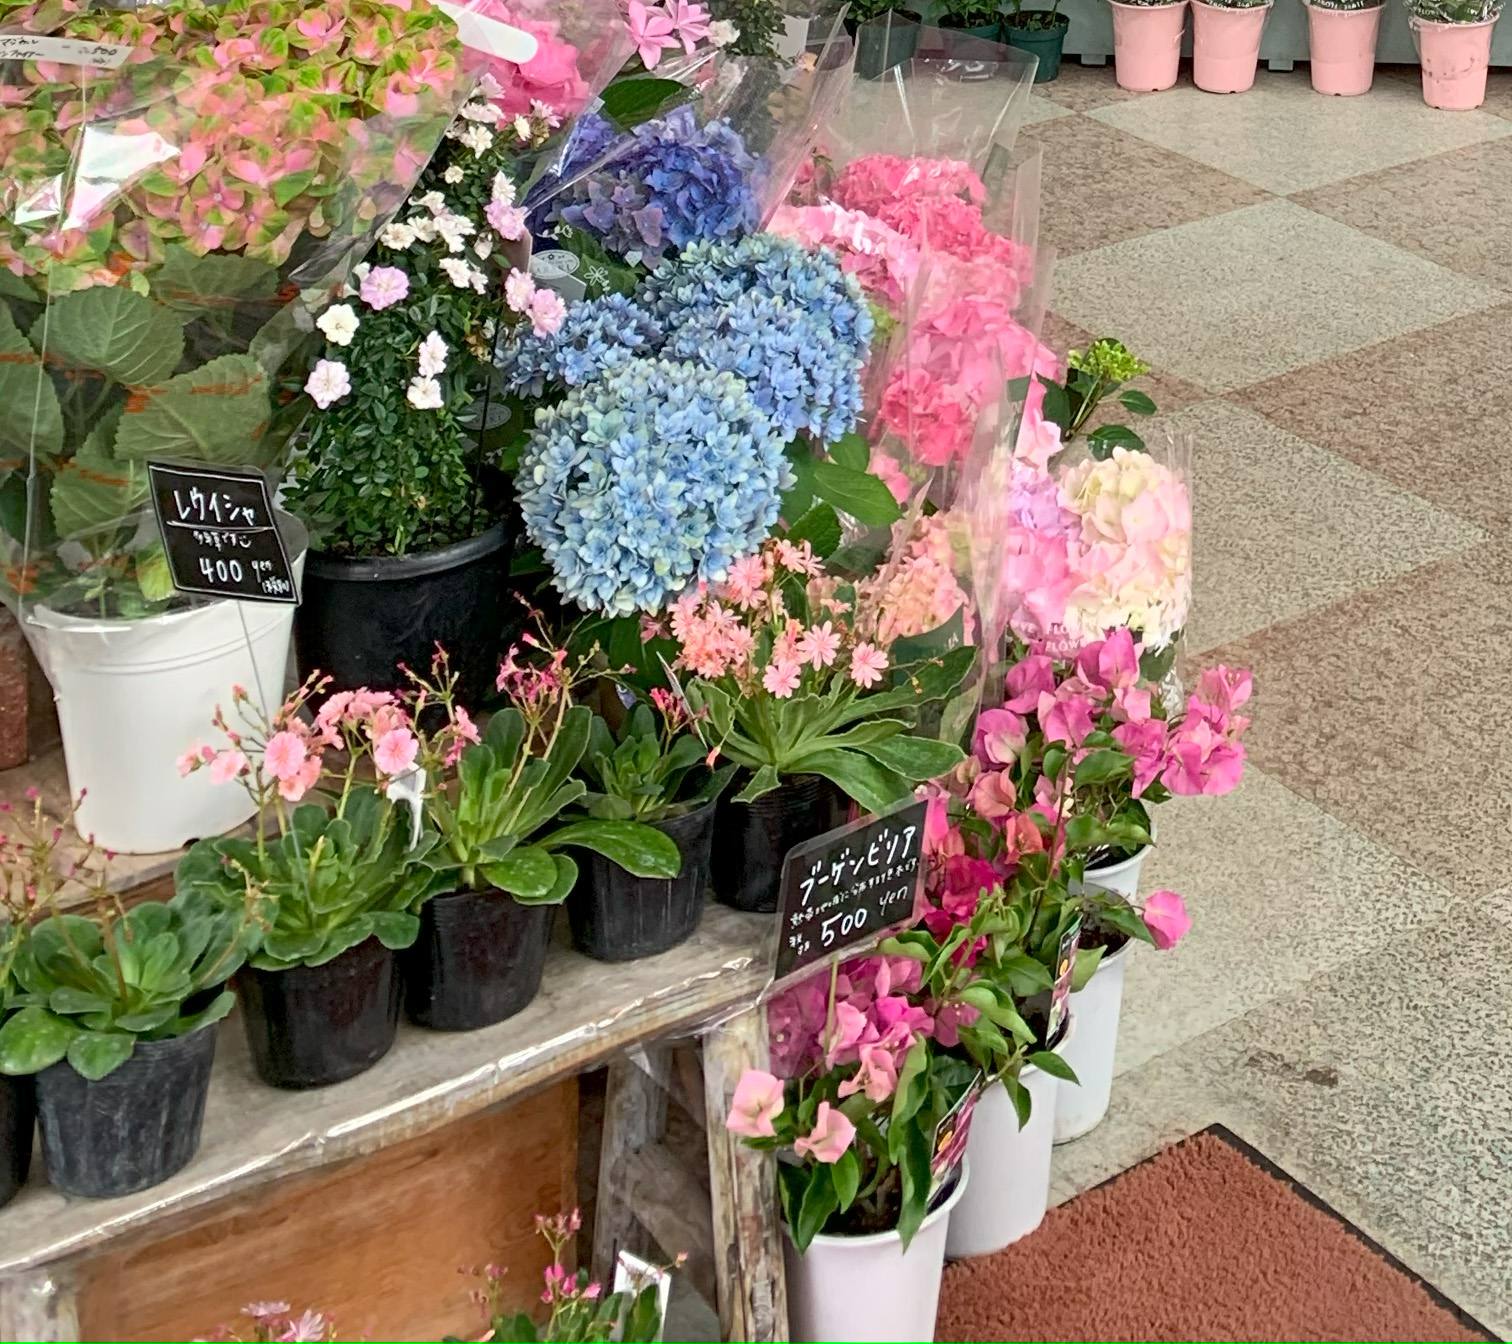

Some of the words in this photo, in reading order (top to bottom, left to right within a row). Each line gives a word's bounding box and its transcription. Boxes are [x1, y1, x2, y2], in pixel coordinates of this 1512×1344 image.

[173, 486, 255, 526] レウイシャ
[199, 557, 243, 583] 400
[800, 826, 916, 906] ブーゲンビリア
[821, 908, 868, 947] 500
[879, 886, 908, 916] yen
